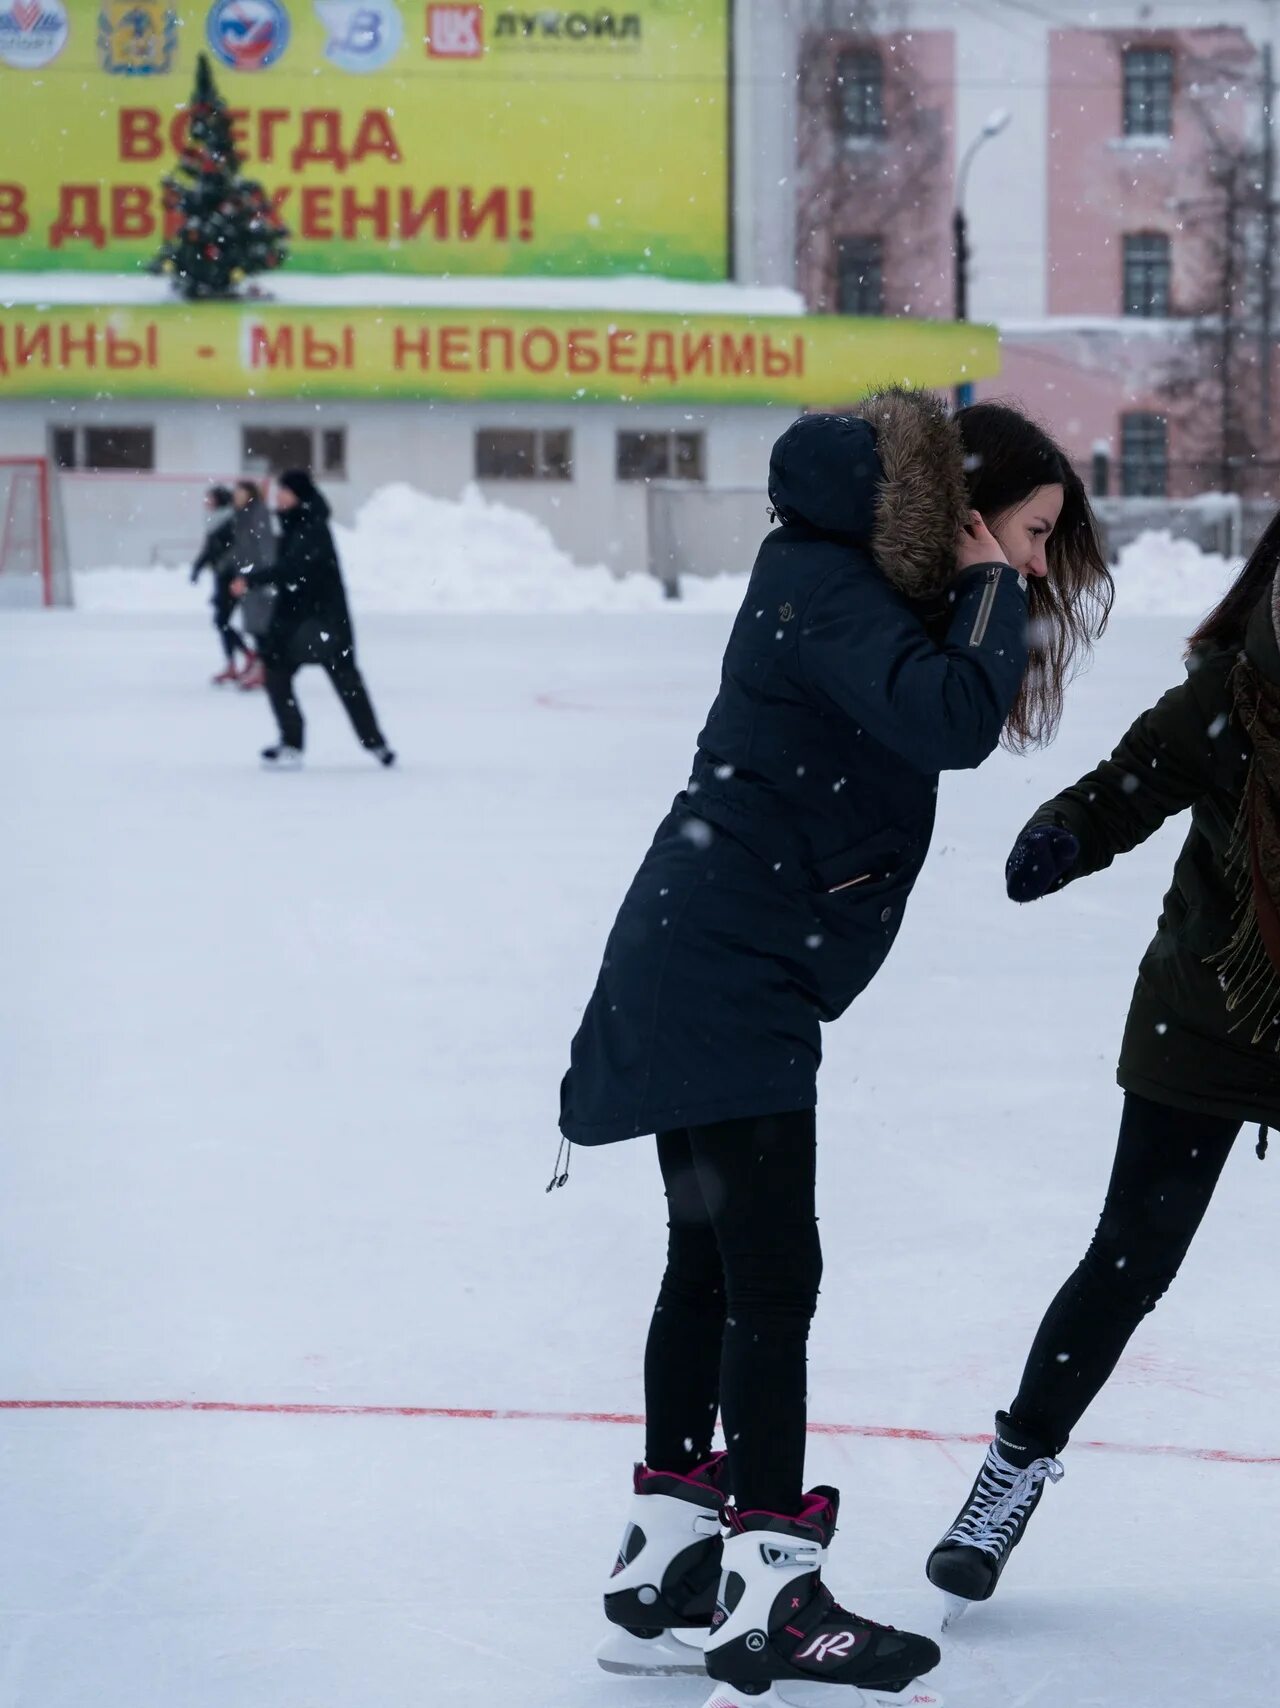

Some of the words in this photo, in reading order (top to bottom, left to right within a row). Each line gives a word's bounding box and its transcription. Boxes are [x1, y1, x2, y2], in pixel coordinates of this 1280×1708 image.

[493, 9, 642, 40] ЛУКОЙЛ
[0, 321, 159, 375] ИНЫ
[249, 323, 354, 372] МЫ
[394, 325, 805, 384] НЕПОБЕДИМЫ
